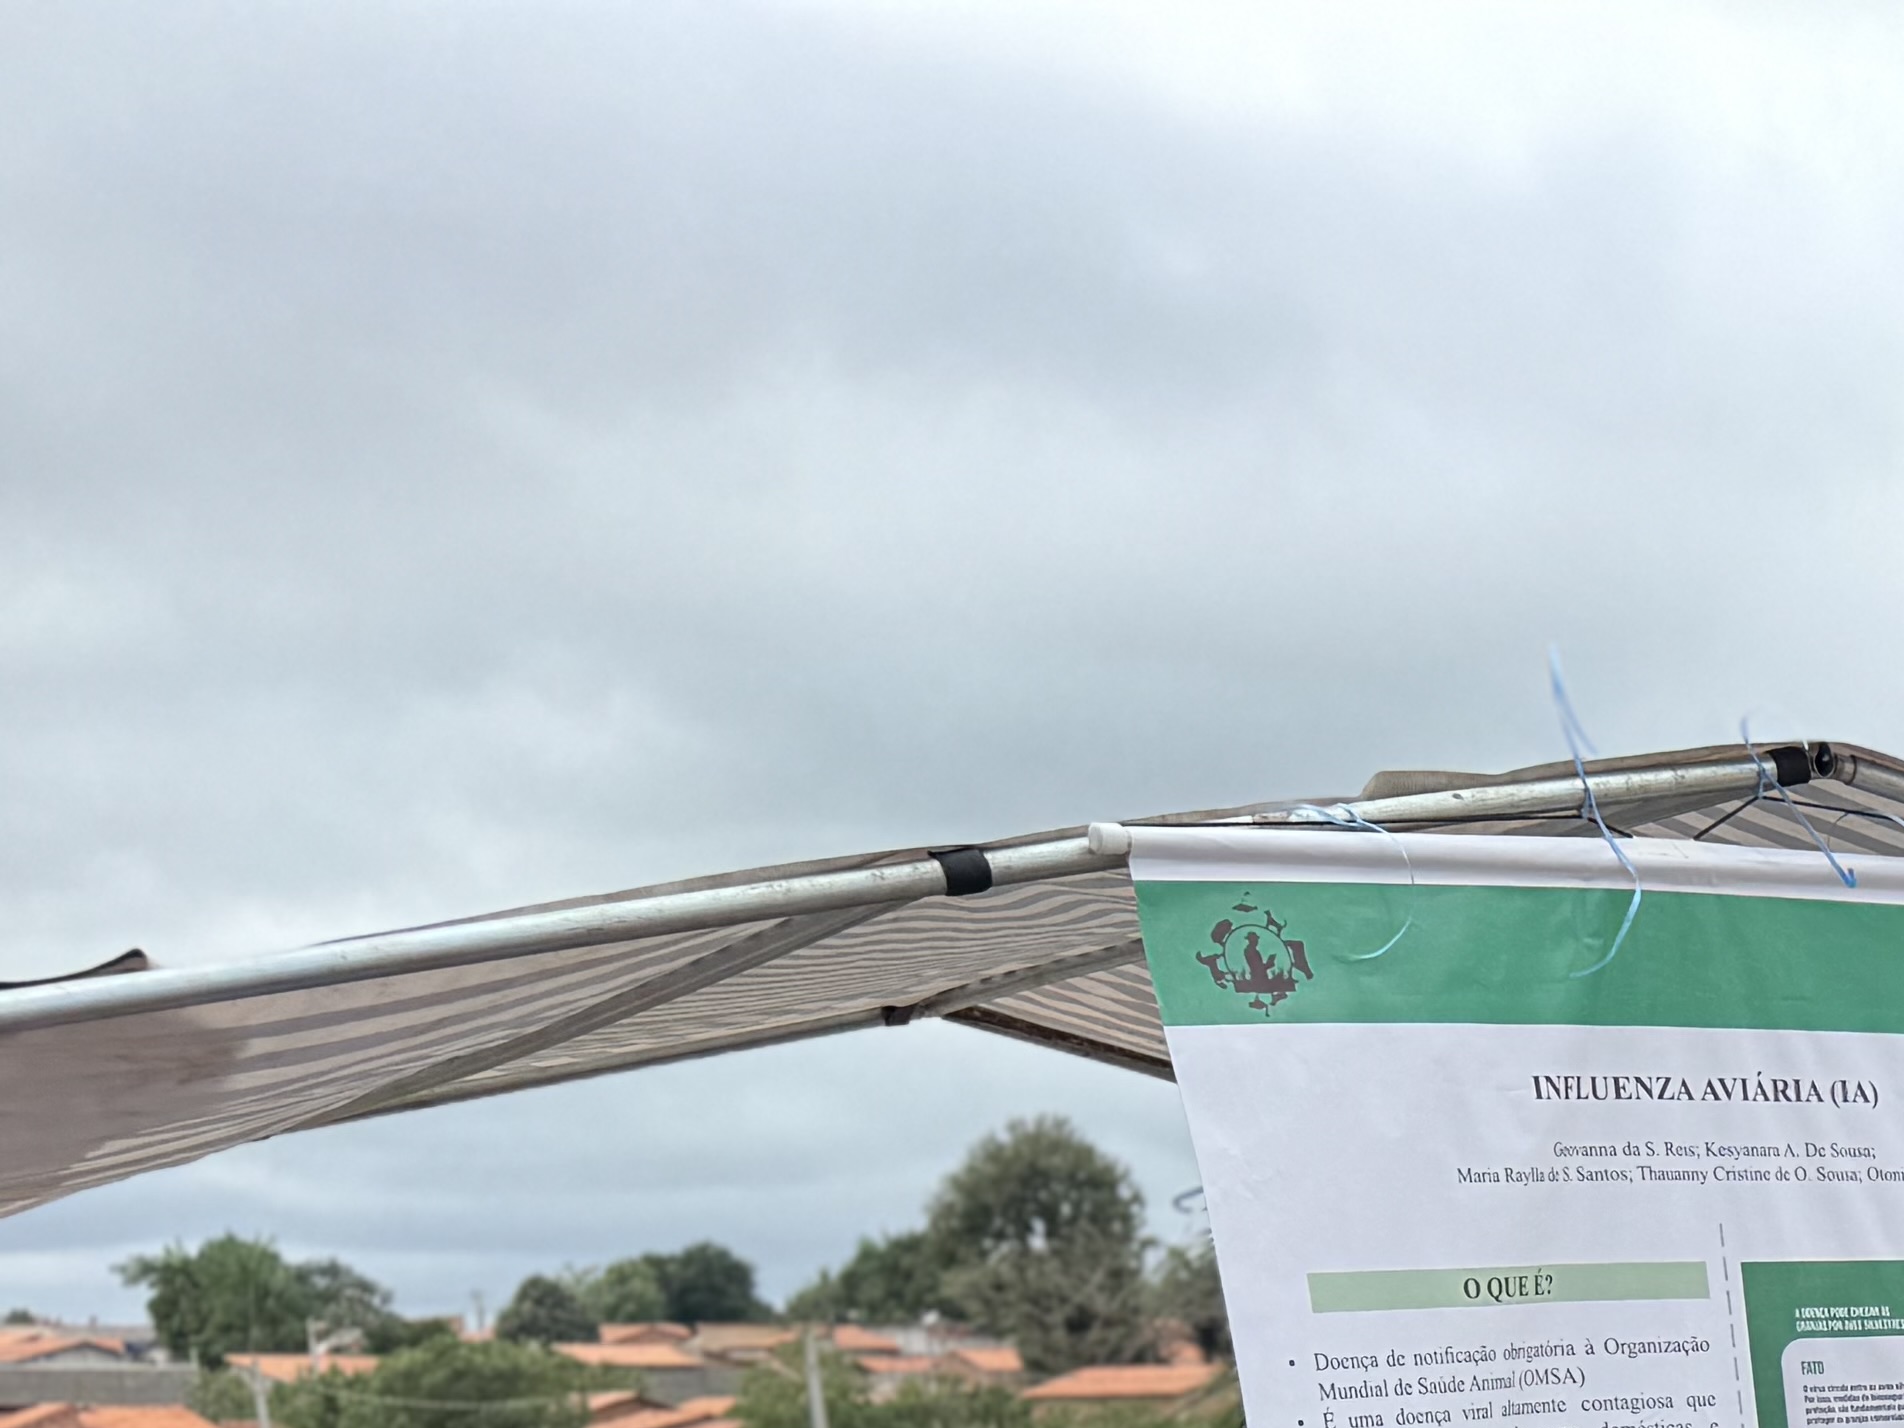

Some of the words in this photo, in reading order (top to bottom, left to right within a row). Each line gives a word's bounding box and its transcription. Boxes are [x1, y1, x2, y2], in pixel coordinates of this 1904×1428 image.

[1531, 1075, 1694, 1100] INFLUENZA
[1701, 1071, 1823, 1103] AVIÁRIA
[1830, 1079, 1879, 1109] (IA)
[1623, 1142, 1641, 1158] da
[1645, 1142, 1659, 1158] S.
[1663, 1142, 1700, 1159] Reis;
[1805, 1142, 1826, 1158] De
[1457, 1167, 1499, 1184] Maria
[1576, 1166, 1632, 1183] Santos;
[1713, 1166, 1771, 1182] Cristine
[1775, 1166, 1791, 1182] de
[1463, 1278, 1480, 1300] O
[1487, 1275, 1529, 1302] QUE
[1534, 1268, 1554, 1296] É?
[1313, 1352, 1378, 1373] Doença
[1386, 1352, 1405, 1367] de
[1413, 1345, 1496, 1367] notificação
[1503, 1339, 1576, 1361] obrigatória
[1585, 1338, 1595, 1355] à
[1604, 1336, 1710, 1358] Organização
[1802, 1361, 1825, 1375] FATO
[1318, 1380, 1388, 1401] Mundial
[1394, 1378, 1413, 1396] de
[1418, 1376, 1465, 1394] Saúde
[1469, 1371, 1516, 1392] Animal
[1519, 1367, 1585, 1390] (OMSA)
[1348, 1415, 1384, 1428] uma
[1395, 1408, 1451, 1426] doença
[1463, 1403, 1493, 1420] viral
[1501, 1398, 1566, 1417] altamente
[1581, 1393, 1674, 1415] contagiosa
[1686, 1394, 1716, 1410] que
